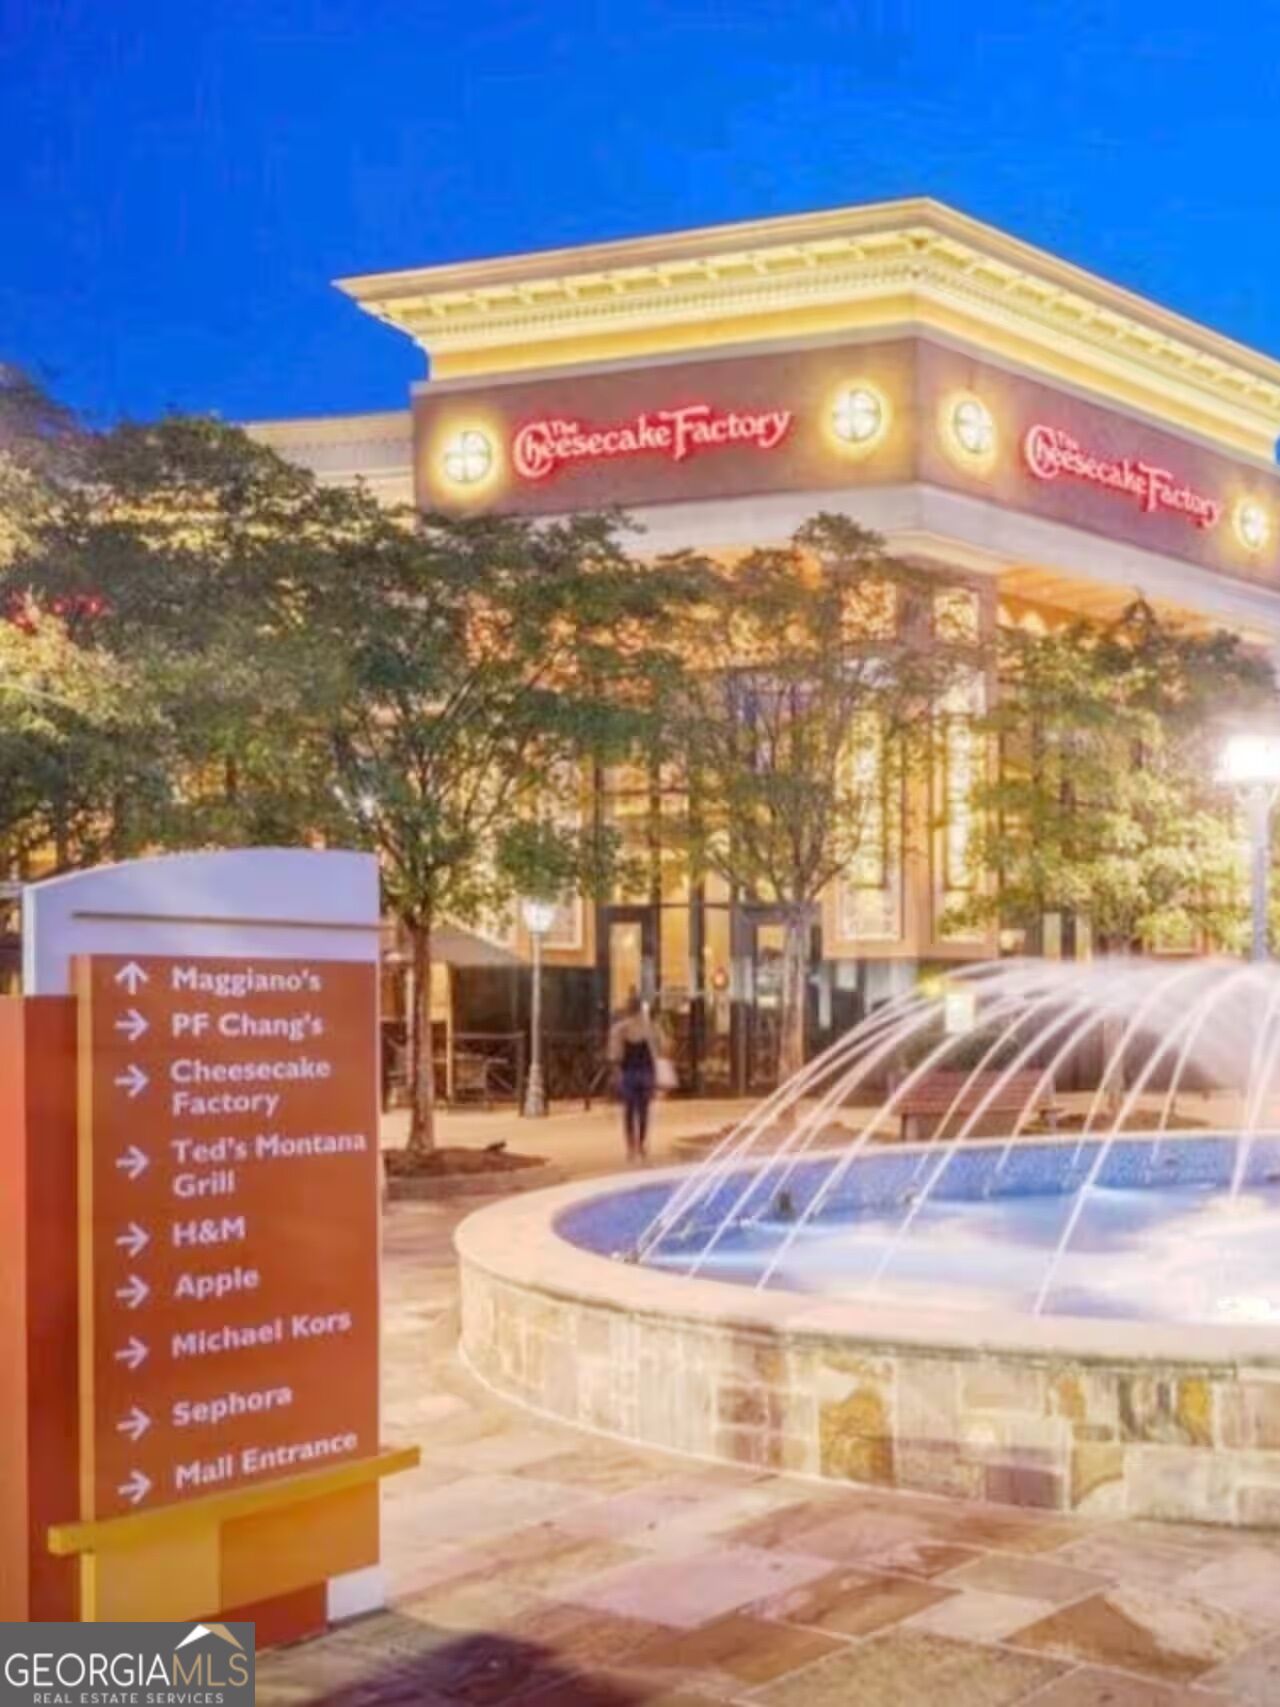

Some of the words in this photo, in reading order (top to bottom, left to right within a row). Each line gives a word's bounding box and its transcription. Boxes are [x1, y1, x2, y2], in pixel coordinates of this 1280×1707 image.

[514, 414, 672, 478] Cheesecake
[659, 405, 792, 461] Factory
[1025, 424, 1147, 494] Cheesecake
[1137, 461, 1219, 527] Factory
[171, 966, 322, 996] Maggiano's
[172, 1013, 210, 1038] PF
[217, 1012, 325, 1040] Chang's
[170, 1057, 331, 1083] Cheesecake
[172, 1092, 280, 1118] Factory
[172, 1139, 248, 1164] Ted's
[255, 1132, 367, 1158] Montana
[173, 1171, 236, 1197] Grill
[172, 1216, 246, 1247] H&M
[174, 1266, 261, 1299] Apple
[172, 1318, 283, 1358] Michael
[291, 1311, 352, 1339] Kors
[172, 1384, 293, 1427] Sephora
[175, 1456, 233, 1489] Mall
[241, 1433, 358, 1474] Entrance
